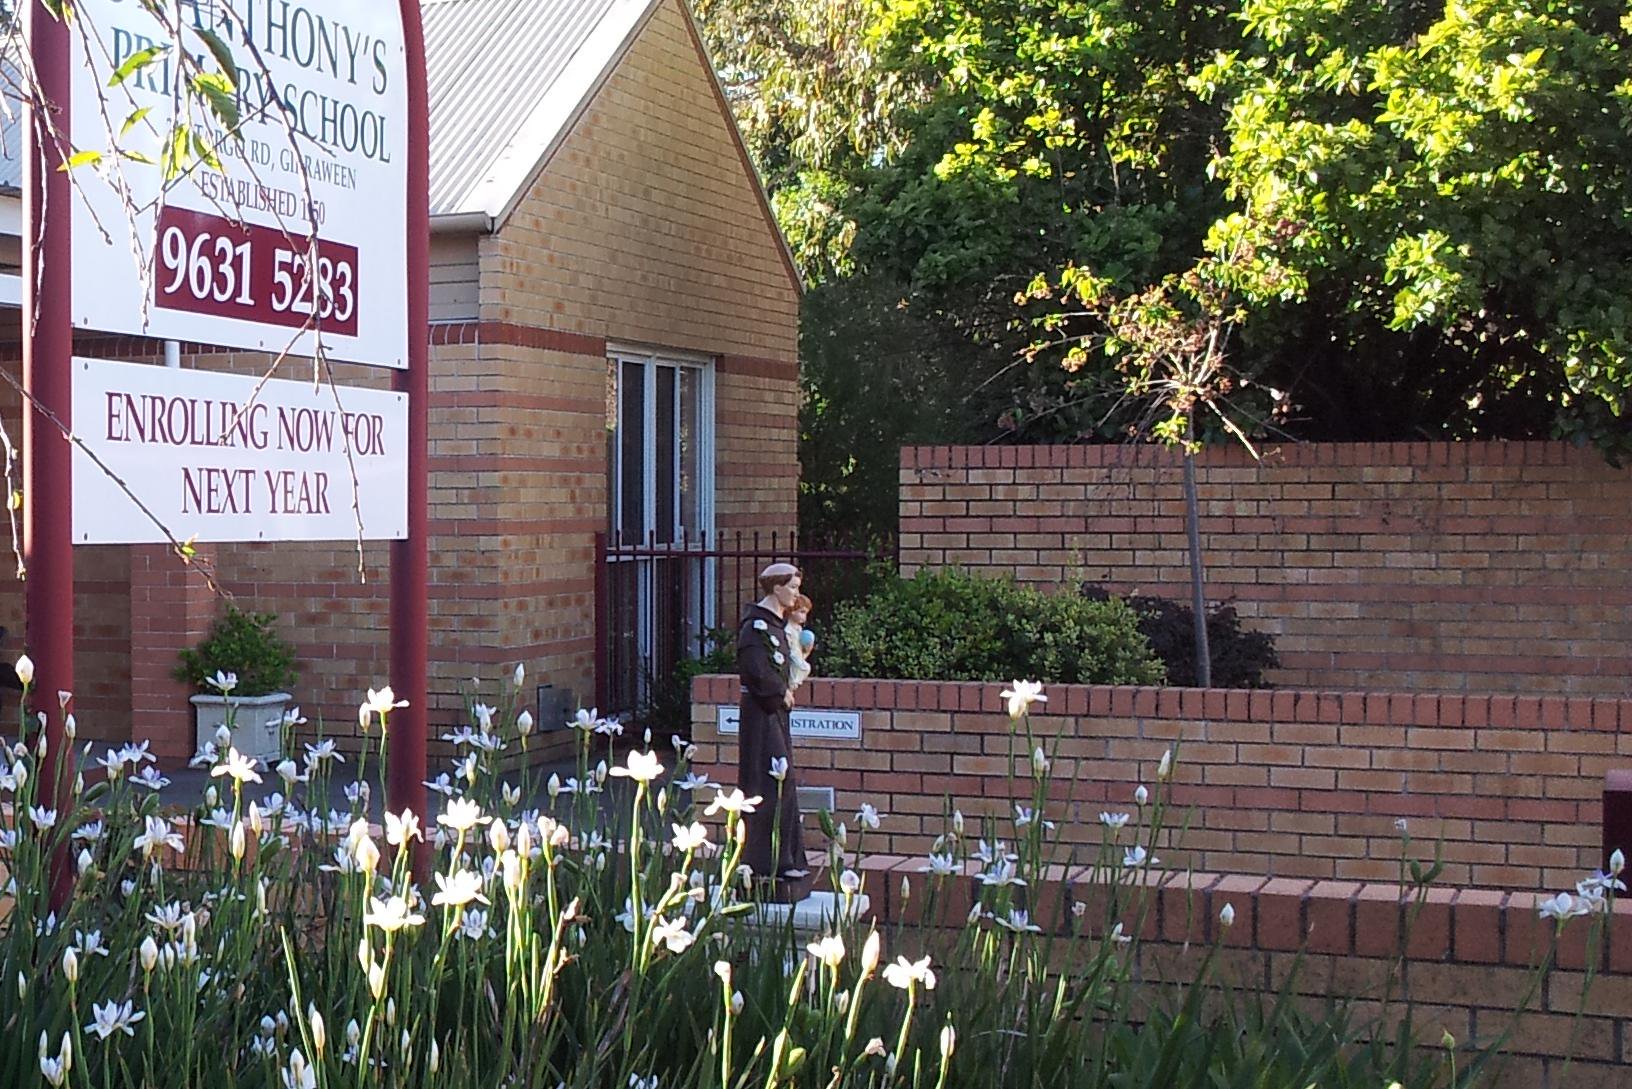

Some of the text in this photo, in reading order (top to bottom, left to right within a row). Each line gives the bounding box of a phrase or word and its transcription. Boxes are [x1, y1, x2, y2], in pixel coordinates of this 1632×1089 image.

[111, 26, 390, 163] PRIRY SCHOOL
[194, 123, 245, 159] TRGO
[252, 140, 274, 171] RD,
[201, 171, 325, 225] ESTABLISHED 150
[161, 226, 354, 321] 9631 5283
[105, 392, 385, 456] ENROLLING NOW FOR
[182, 467, 330, 514] NEXT YEAR
[791, 718, 854, 731] ISTRATION
